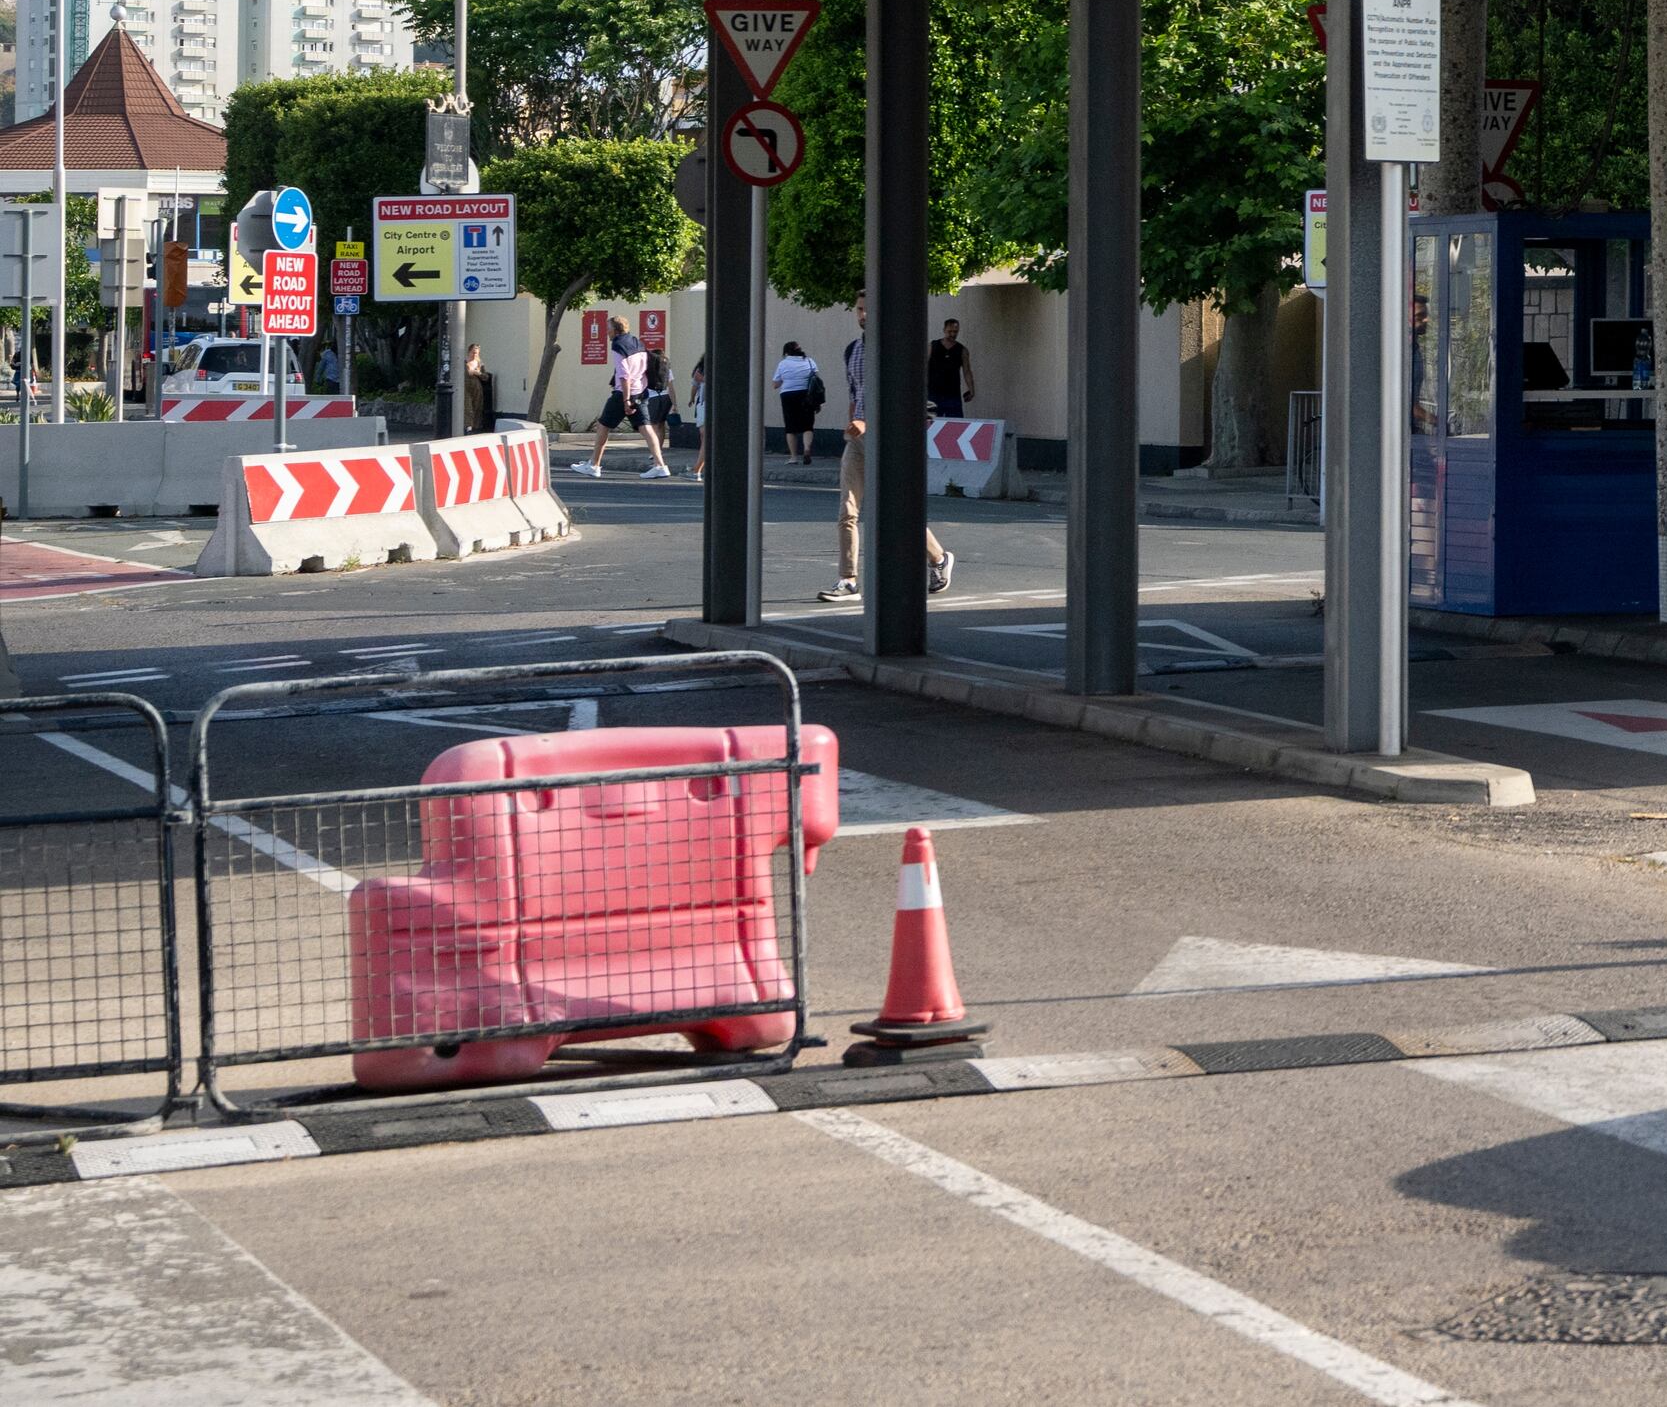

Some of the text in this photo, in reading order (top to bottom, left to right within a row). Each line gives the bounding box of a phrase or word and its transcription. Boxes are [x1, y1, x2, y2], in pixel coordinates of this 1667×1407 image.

[1393, 0, 1411, 8] ANPR
[731, 14, 794, 32] GIVE
[745, 39, 785, 51] WAY
[1484, 92, 1516, 111] IVE
[381, 203, 506, 215] NEW ROAD LAYOUT
[1312, 198, 1327, 207] NE
[384, 231, 437, 240] City Centre
[397, 246, 435, 255] Airport
[276, 257, 304, 272] NEW
[273, 276, 307, 291] ROAD
[267, 295, 313, 311] LAYOUT
[268, 314, 310, 329] AHEAD
